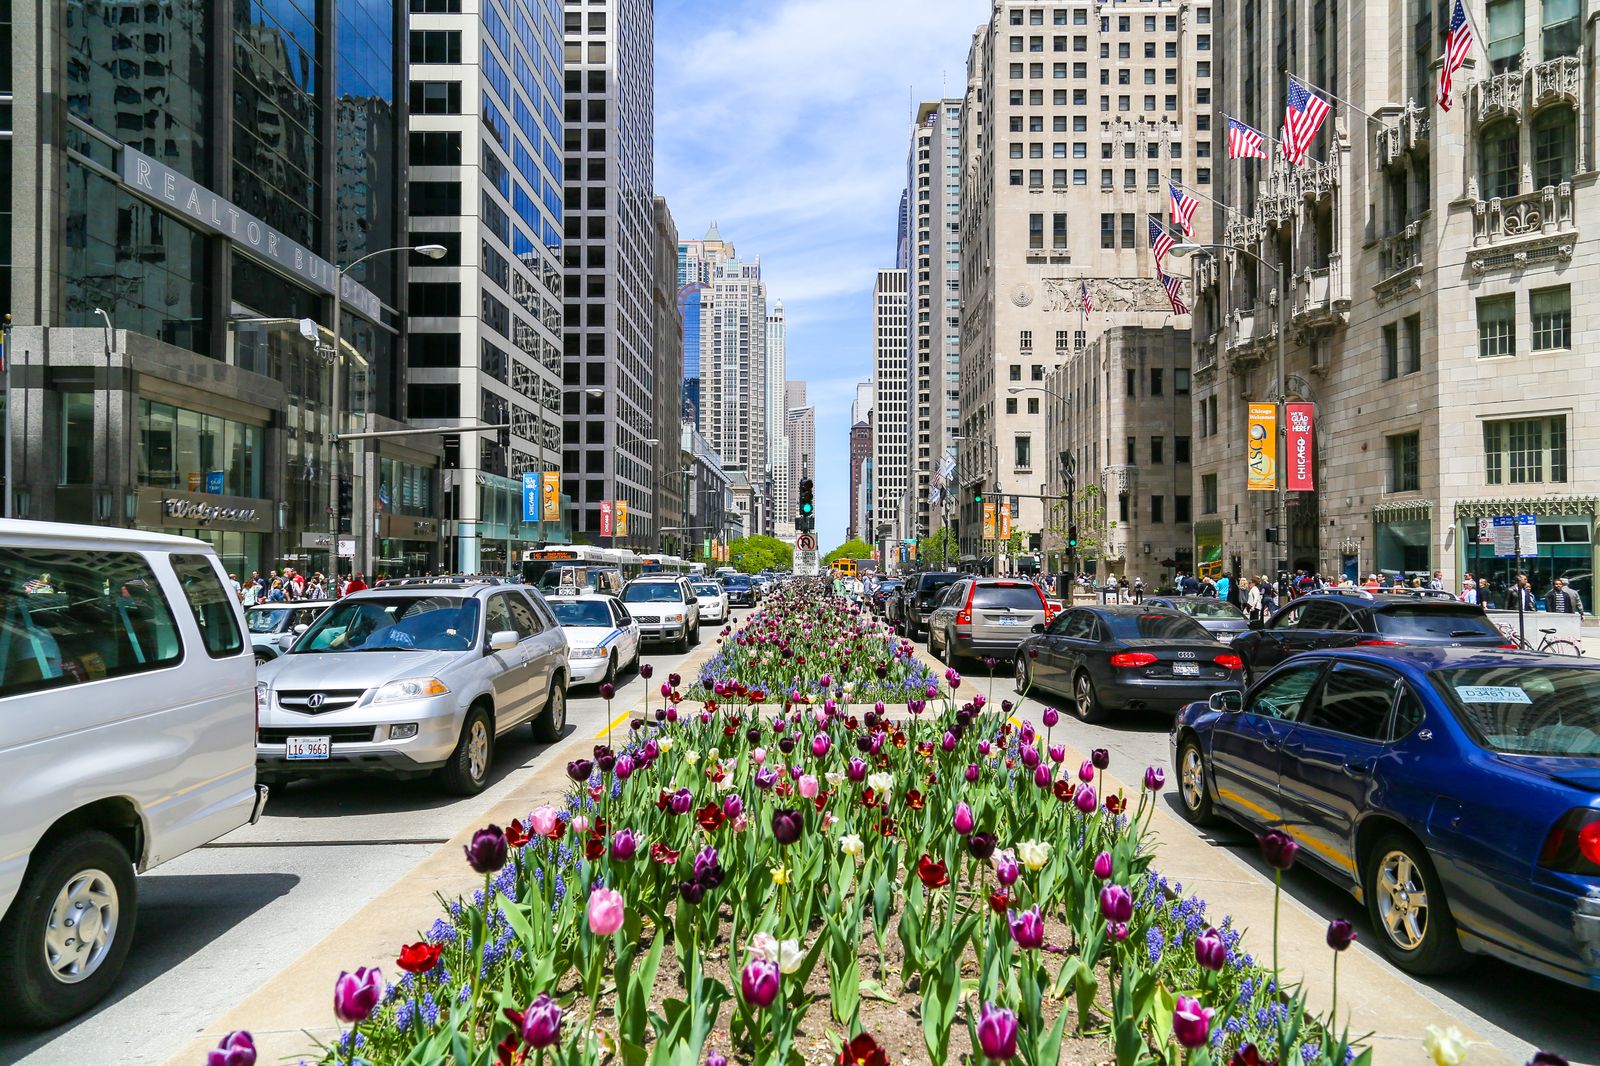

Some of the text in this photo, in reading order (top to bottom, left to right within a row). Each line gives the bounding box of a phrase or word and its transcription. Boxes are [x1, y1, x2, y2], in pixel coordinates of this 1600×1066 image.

[294, 247, 379, 318] BUILDING
[1249, 424, 1267, 471] ASCO
[1292, 425, 1310, 435] HERE!
[1297, 437, 1306, 480] CHICAGO
[289, 743, 327, 755] L16 9663
